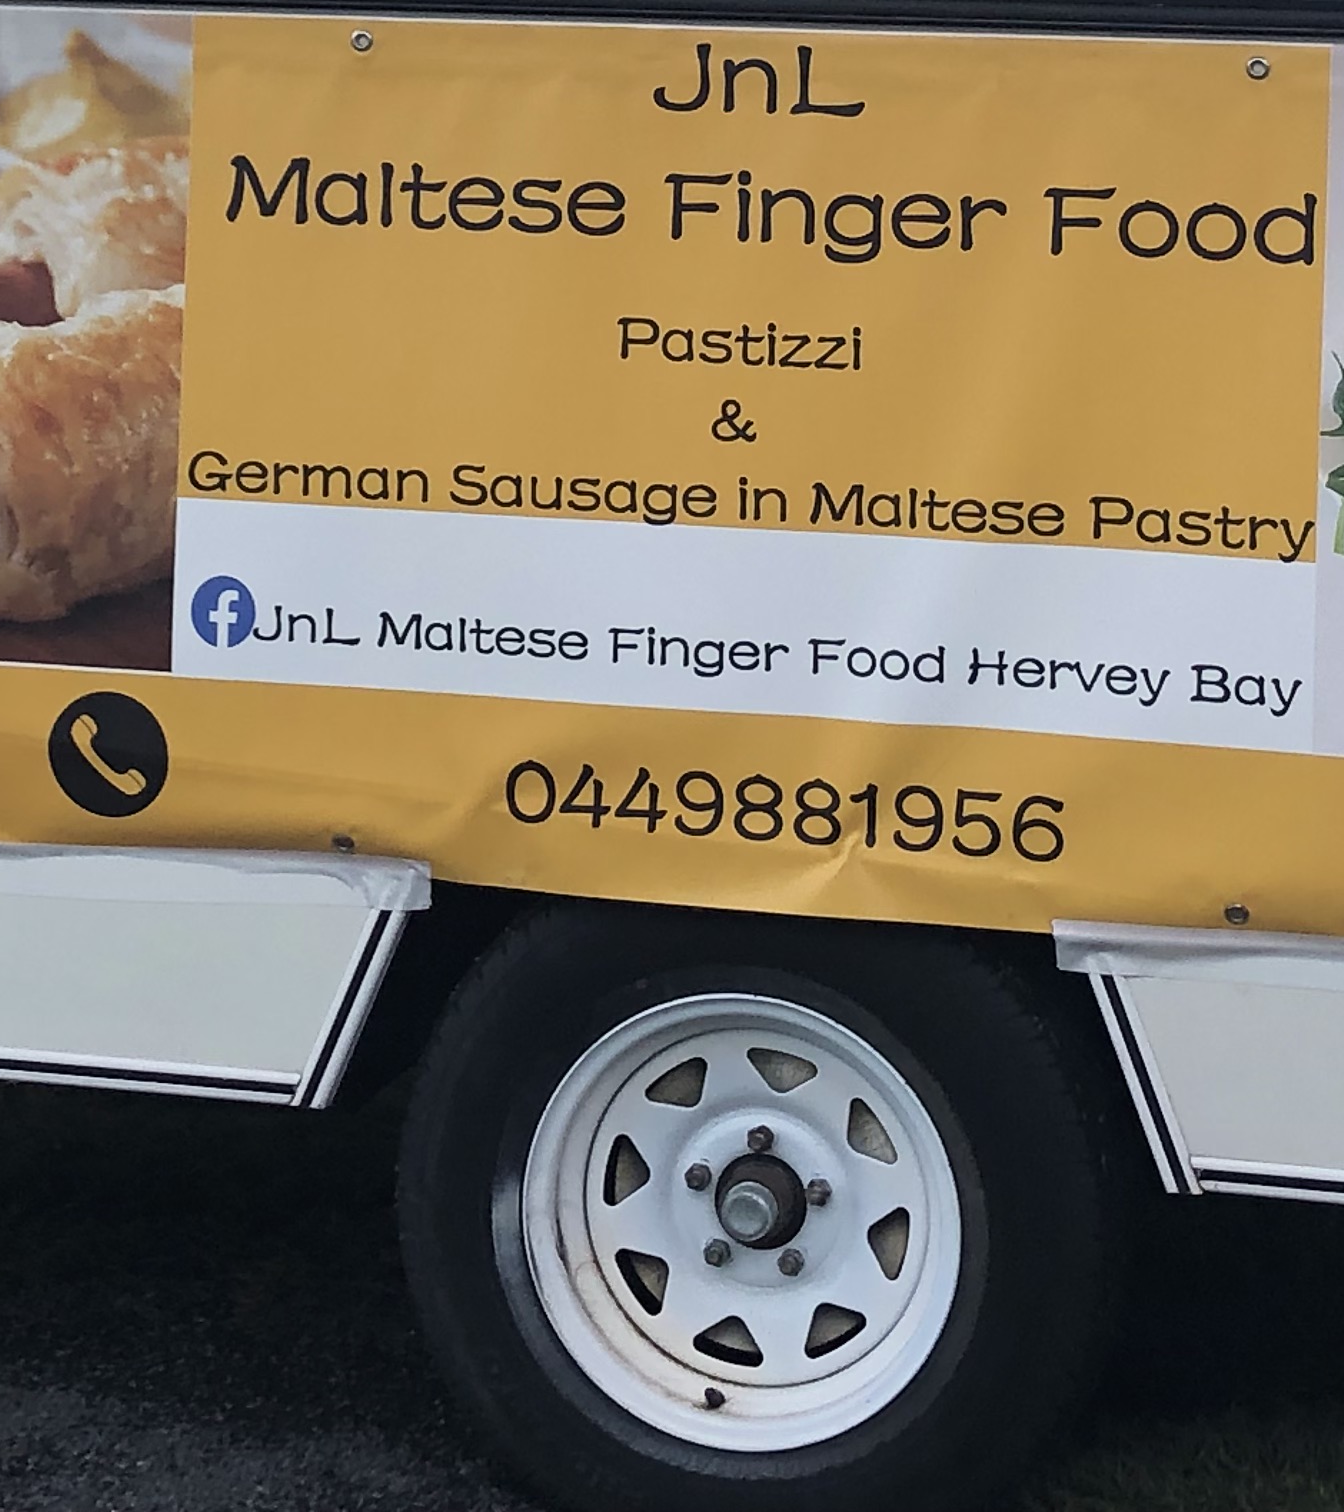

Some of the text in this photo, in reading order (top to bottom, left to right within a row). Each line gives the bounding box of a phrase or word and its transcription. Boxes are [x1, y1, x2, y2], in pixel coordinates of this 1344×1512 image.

[653, 43, 866, 118] JnL
[225, 154, 1318, 266] Maltese Finger Food
[616, 316, 863, 371] Pastizzi
[711, 399, 758, 443] &
[187, 451, 1316, 564] German Sausage in Maltese Pastry
[252, 604, 361, 647] JnL
[376, 612, 590, 662] Maltese
[608, 626, 790, 678] Finger
[807, 637, 947, 684] Food
[966, 647, 1171, 707] Hervey
[1189, 664, 1303, 718] Bay
[505, 759, 1066, 863] 0449881956
